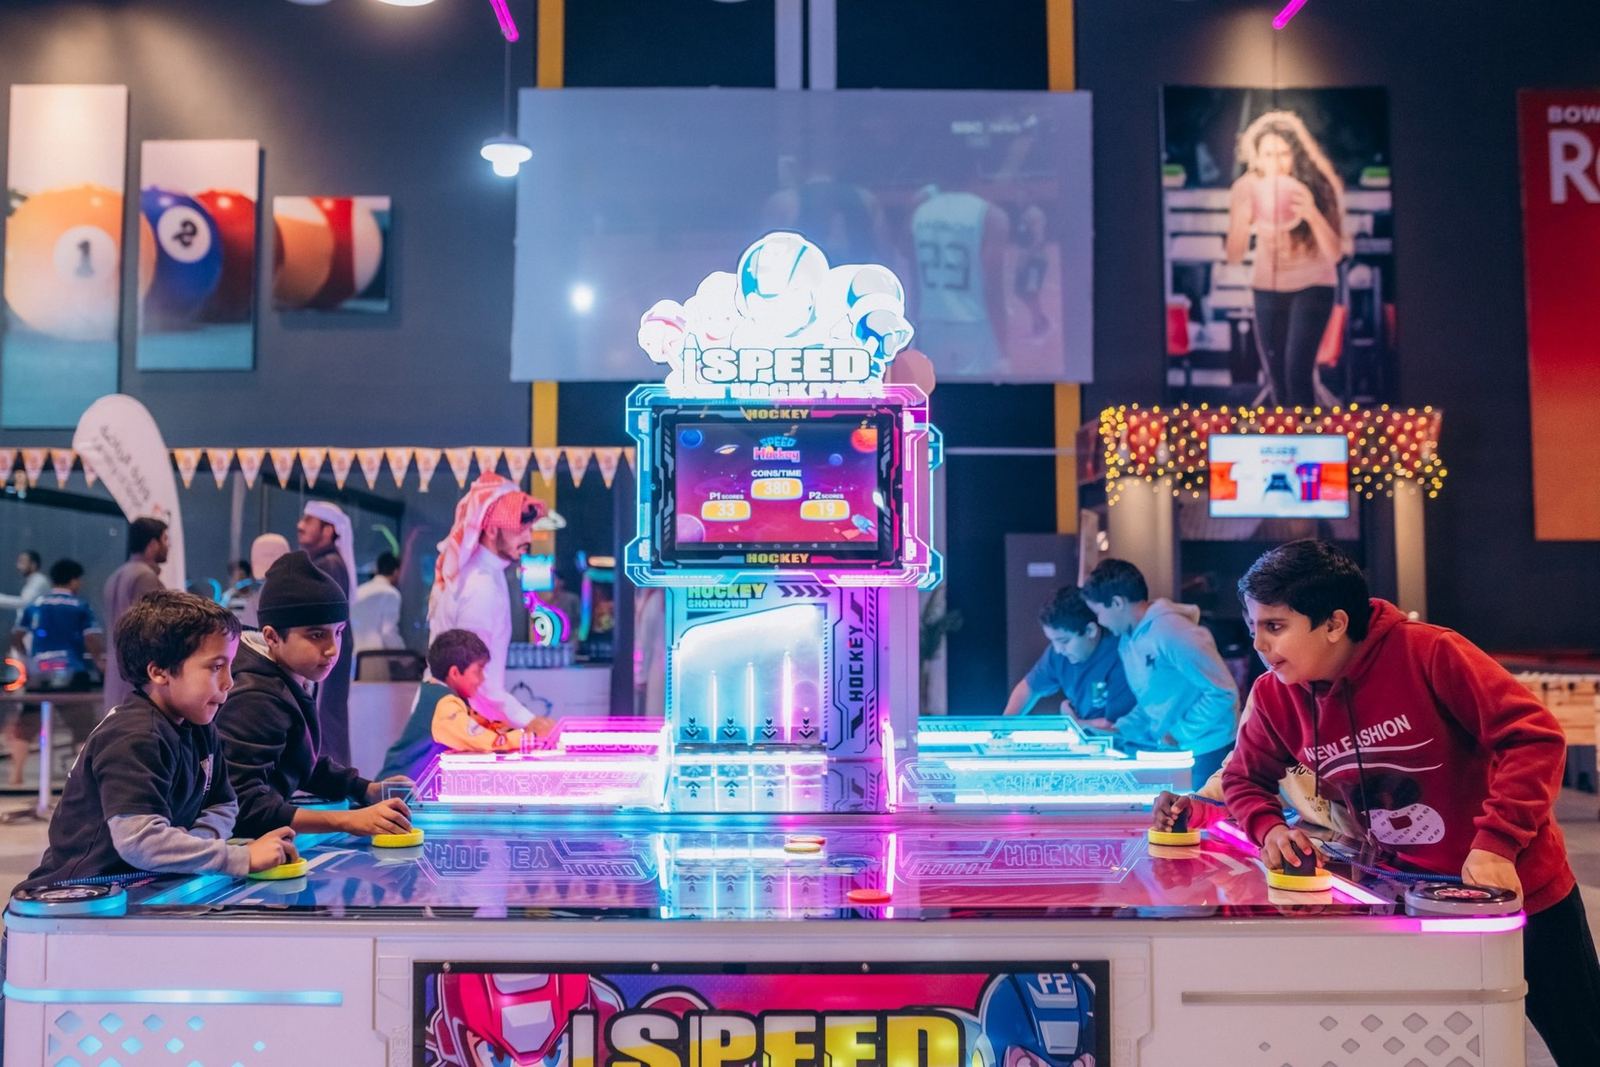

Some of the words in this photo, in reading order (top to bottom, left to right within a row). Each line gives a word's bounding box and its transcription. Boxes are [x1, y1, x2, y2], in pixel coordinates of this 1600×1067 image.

[1548, 129, 1600, 204] R
[171, 218, 199, 249] 2
[76, 239, 95, 278] 1
[918, 241, 970, 292] 23
[746, 408, 810, 420] HOCKEY
[758, 435, 797, 448] SPEED
[751, 469, 802, 477] COINS/TIME
[763, 481, 791, 495] 380
[709, 491, 721, 500] P1
[808, 491, 821, 500] P2
[717, 503, 736, 517] 33
[817, 503, 835, 517] 19
[746, 554, 810, 564] HOCKEY
[687, 583, 767, 600] HOCKEY
[687, 599, 748, 609] SHOWDOWN
[848, 624, 865, 703] HOCKEY
[1303, 739, 1340, 763] NEW
[1037, 972, 1073, 994] P2
